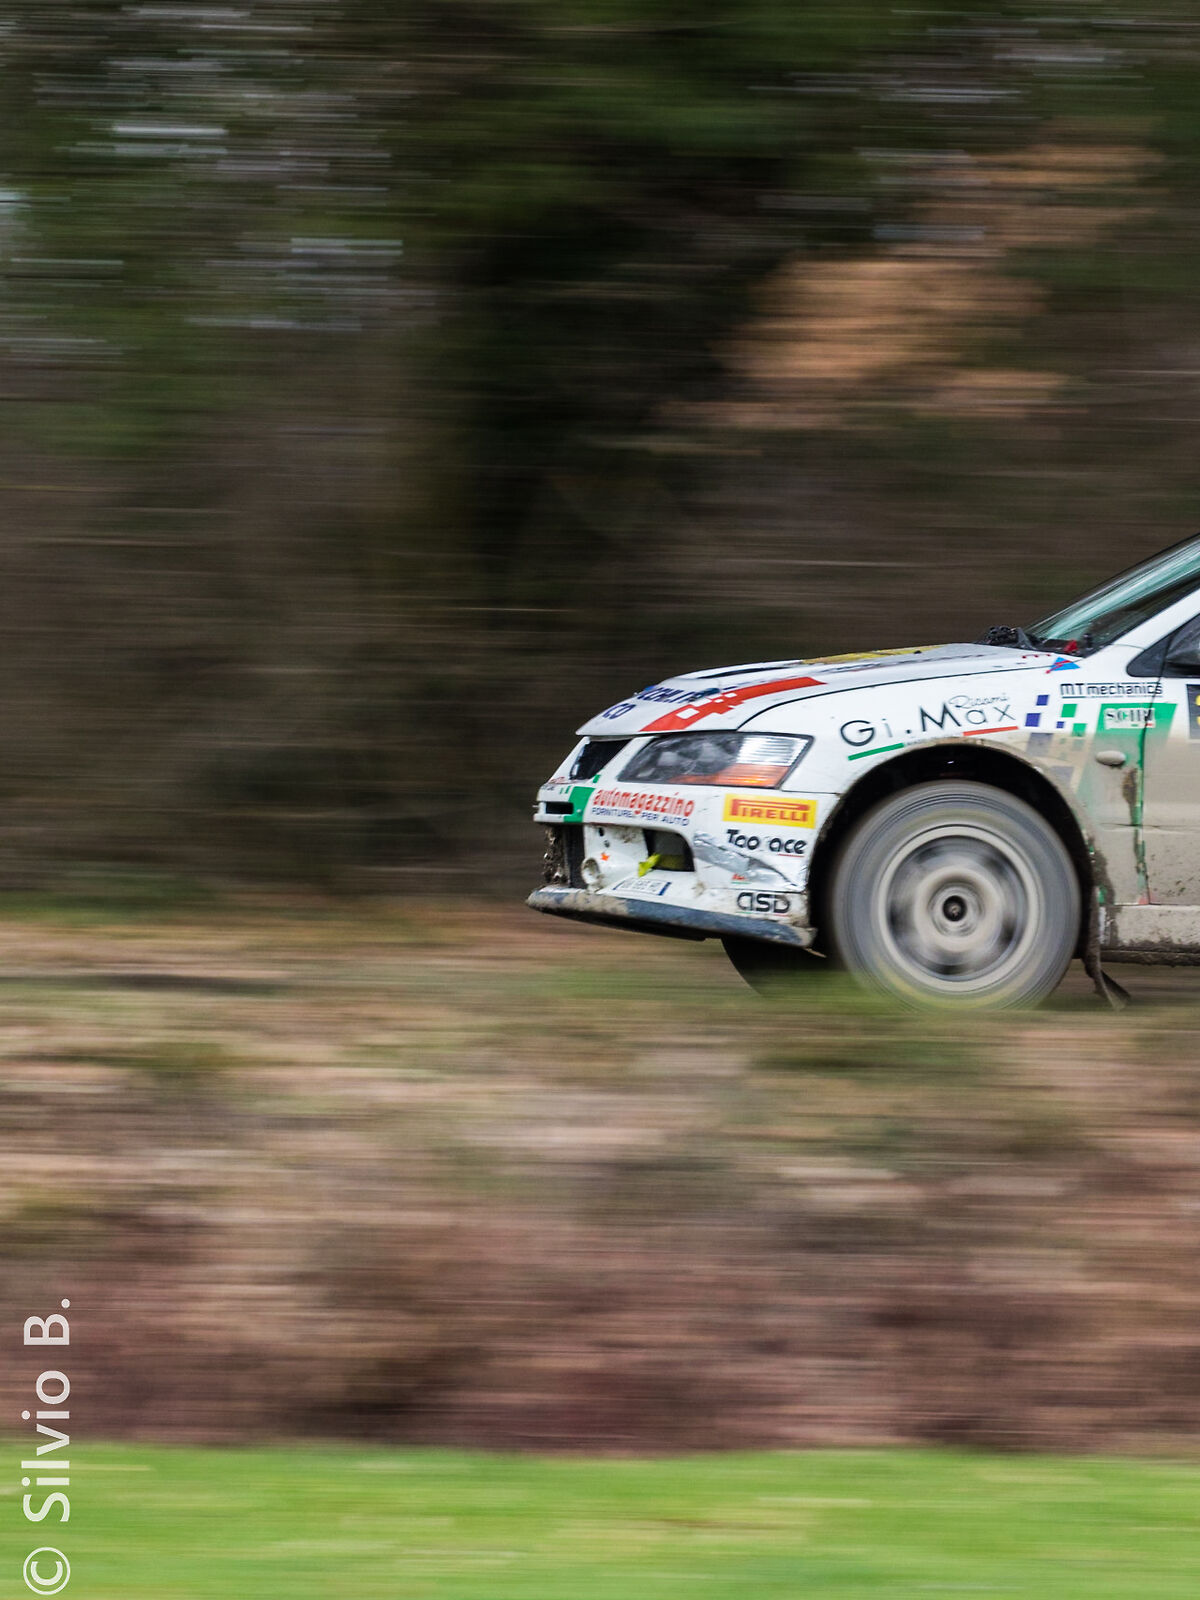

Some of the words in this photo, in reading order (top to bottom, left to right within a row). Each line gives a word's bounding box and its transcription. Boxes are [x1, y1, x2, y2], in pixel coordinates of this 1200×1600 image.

[592, 787, 695, 817] automagazzino
[730, 798, 811, 822] PIRELLI
[641, 811, 659, 821] PER
[661, 815, 690, 827] AUTO
